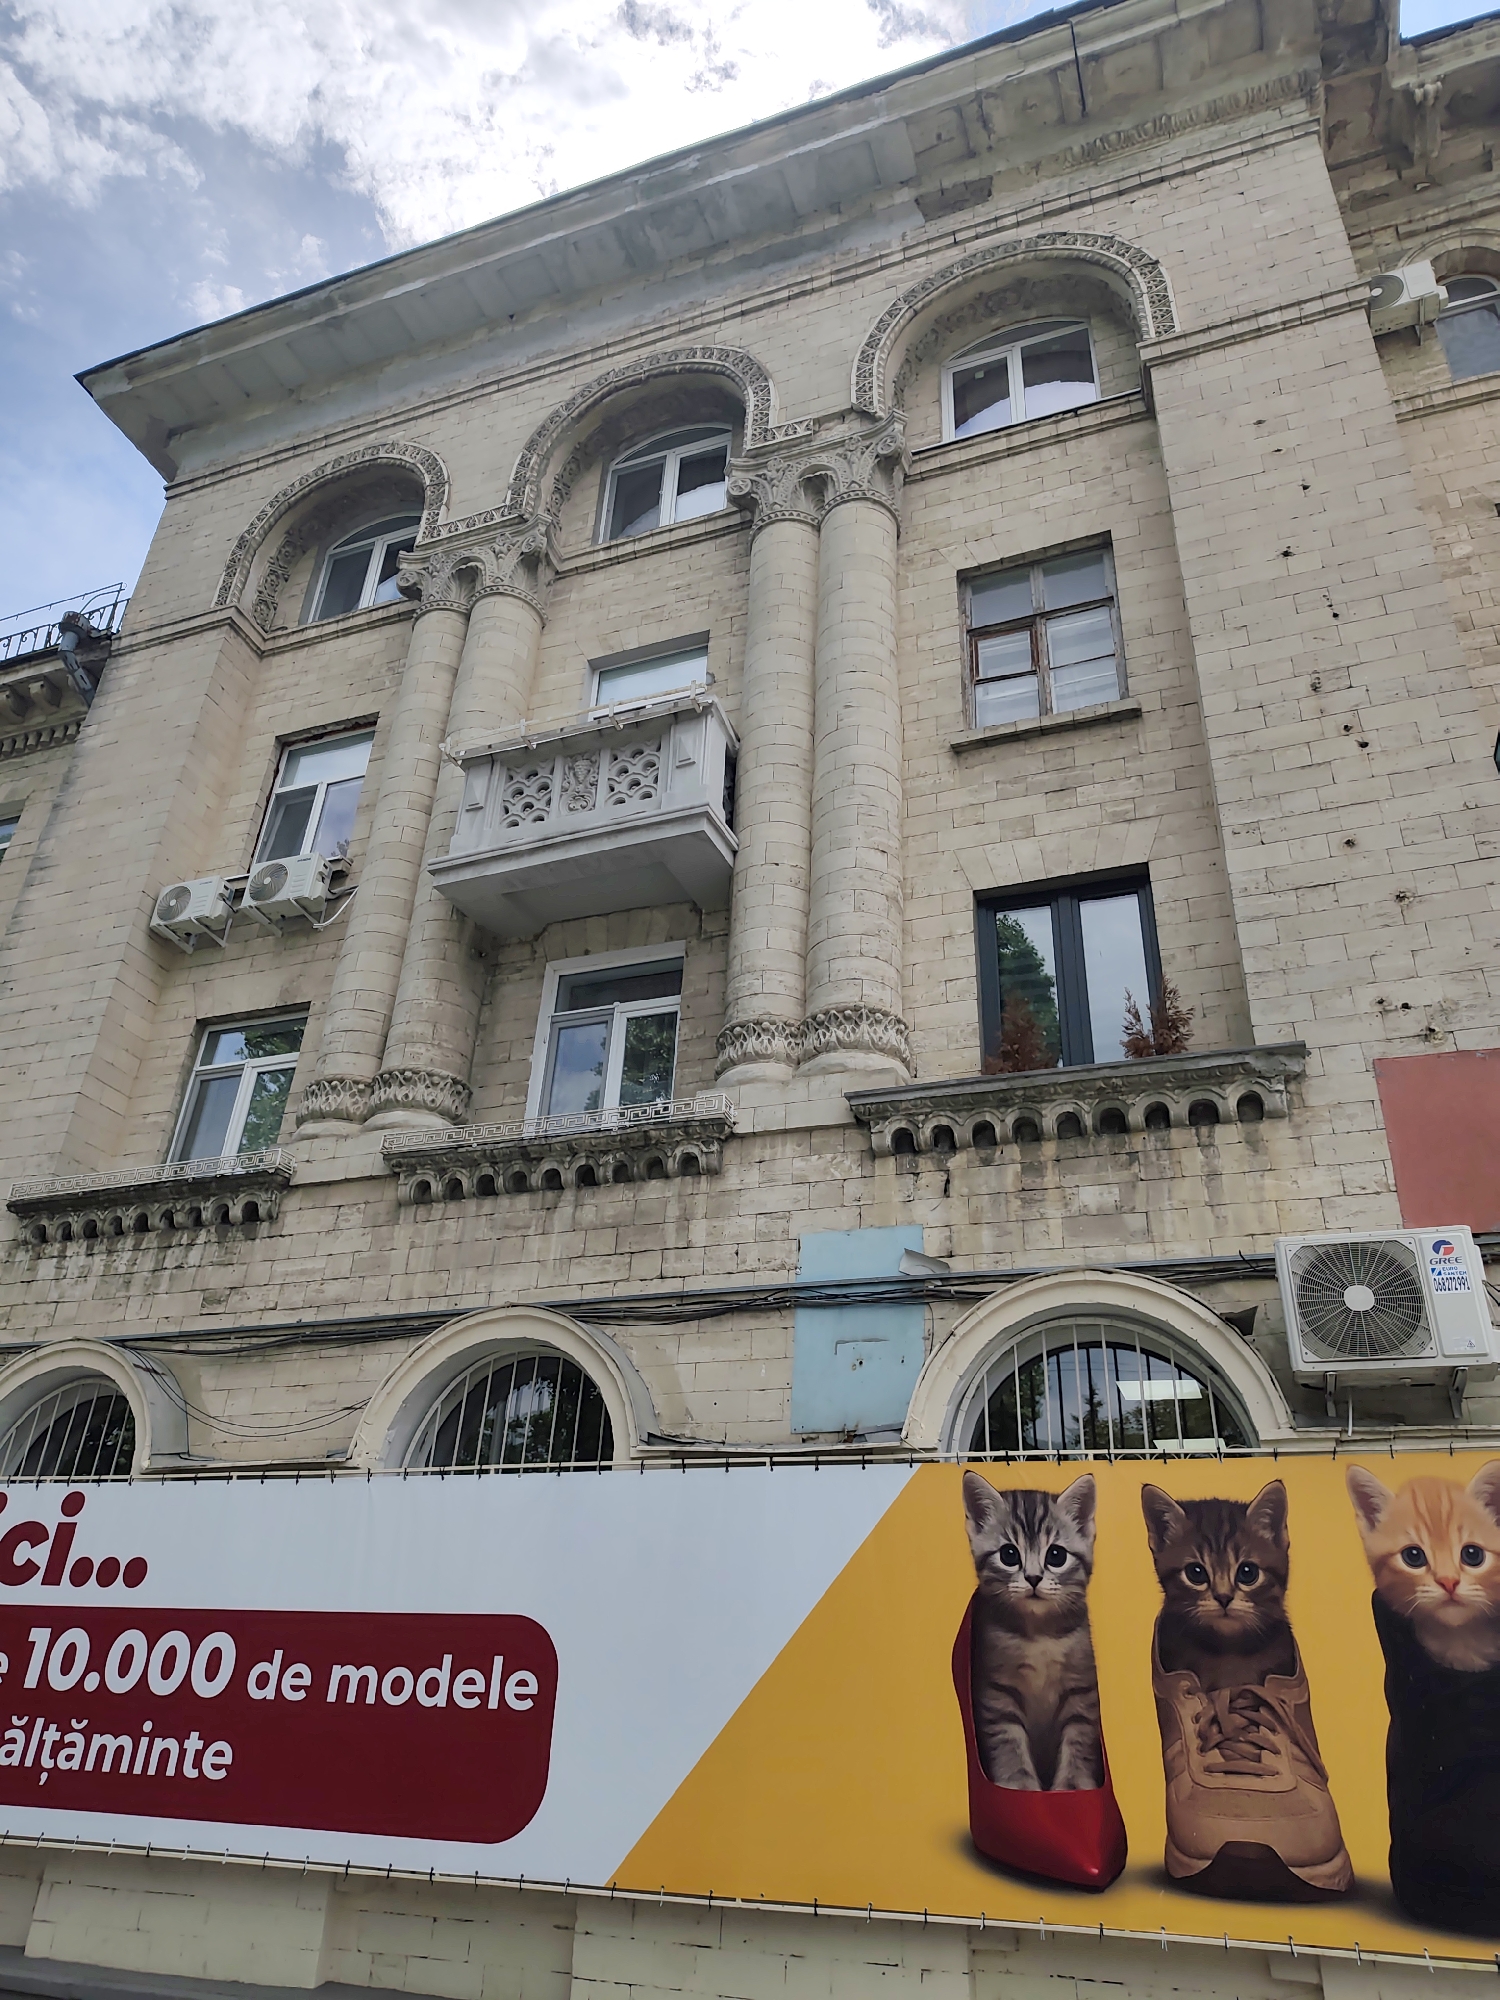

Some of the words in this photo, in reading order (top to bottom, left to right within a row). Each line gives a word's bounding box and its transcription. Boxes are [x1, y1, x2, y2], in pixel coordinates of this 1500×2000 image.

[1429, 1256, 1463, 1265] GREE
[0, 1490, 148, 1589] ci...
[23, 1627, 237, 1699] 10.000
[246, 1649, 312, 1701] de
[326, 1653, 539, 1711] modele
